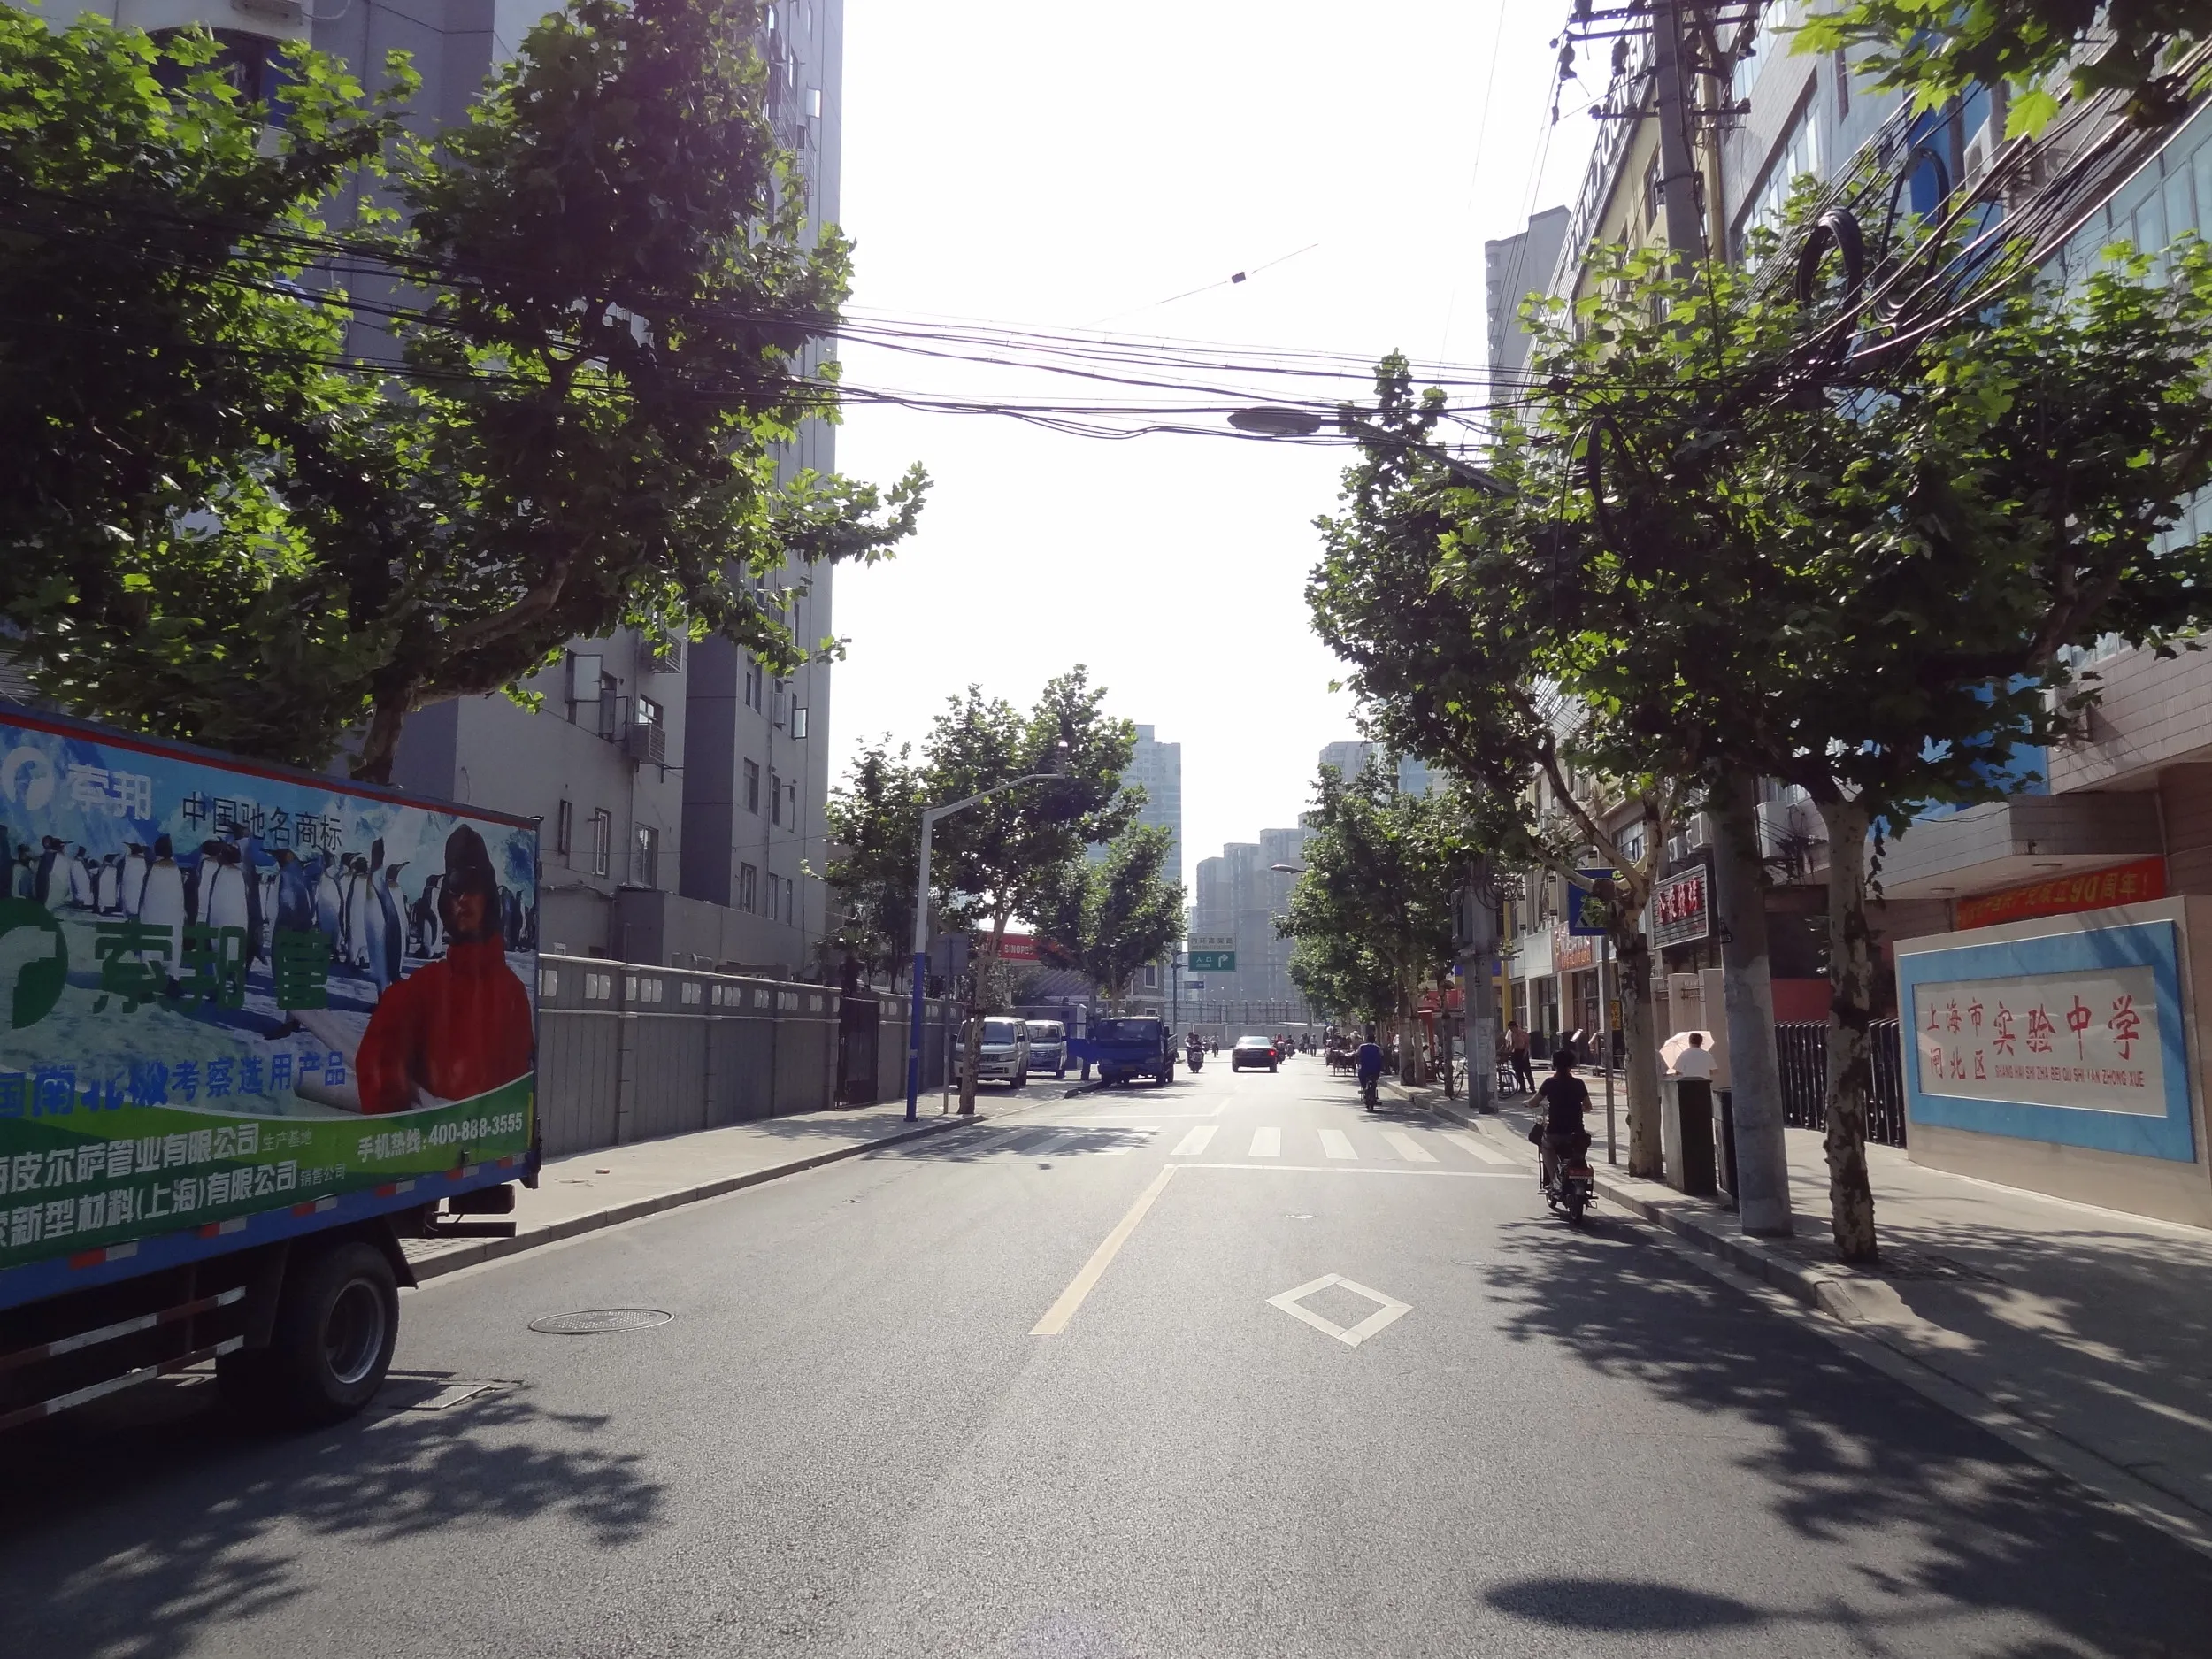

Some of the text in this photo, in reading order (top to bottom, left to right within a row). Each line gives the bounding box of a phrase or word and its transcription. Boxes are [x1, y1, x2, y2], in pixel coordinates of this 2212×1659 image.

[67, 763, 152, 821] 索邦
[181, 791, 344, 851] 中国驰名商标
[1926, 996, 1984, 1037] 上海市
[1992, 994, 2141, 1062] 实验中学
[1930, 1045, 1987, 1081] 闸北区
[2129, 1071, 2146, 1087] XUE
